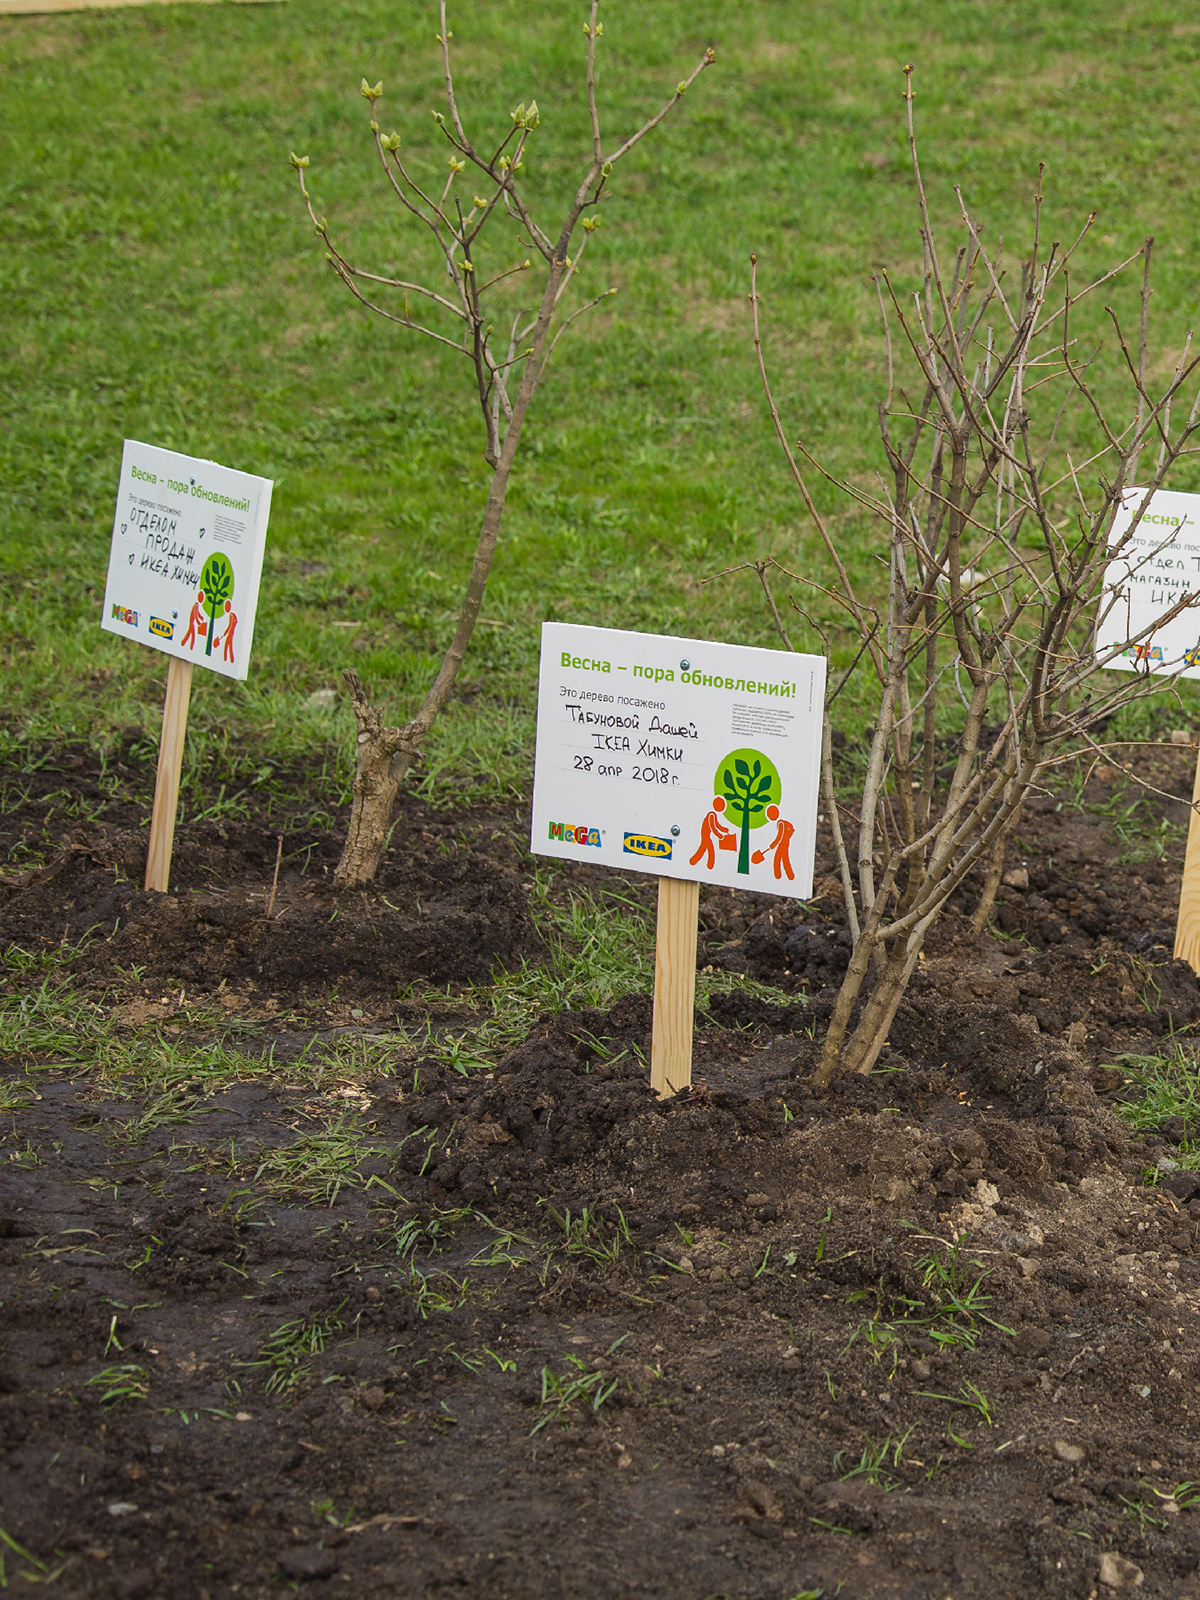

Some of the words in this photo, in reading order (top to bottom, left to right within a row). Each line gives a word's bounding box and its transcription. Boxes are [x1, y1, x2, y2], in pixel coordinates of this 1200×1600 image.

[131, 465, 157, 484] Весна
[166, 479, 189, 494] пора
[190, 485, 250, 512] обновлений!
[130, 507, 177, 536] ОТДЕЛОМ
[145, 533, 196, 565] ПРОДАЖ
[152, 621, 170, 635] IKEA
[561, 652, 611, 673] Весна
[633, 665, 675, 683] пора
[681, 670, 797, 698] обновлений!
[559, 686, 577, 698] Это
[579, 690, 614, 702] дерево
[617, 696, 666, 710] посажено
[649, 715, 698, 739] Дашей
[591, 733, 630, 751] IKEA
[573, 755, 594, 771] 28
[598, 764, 623, 776] апр
[630, 838, 667, 853] IKEA
